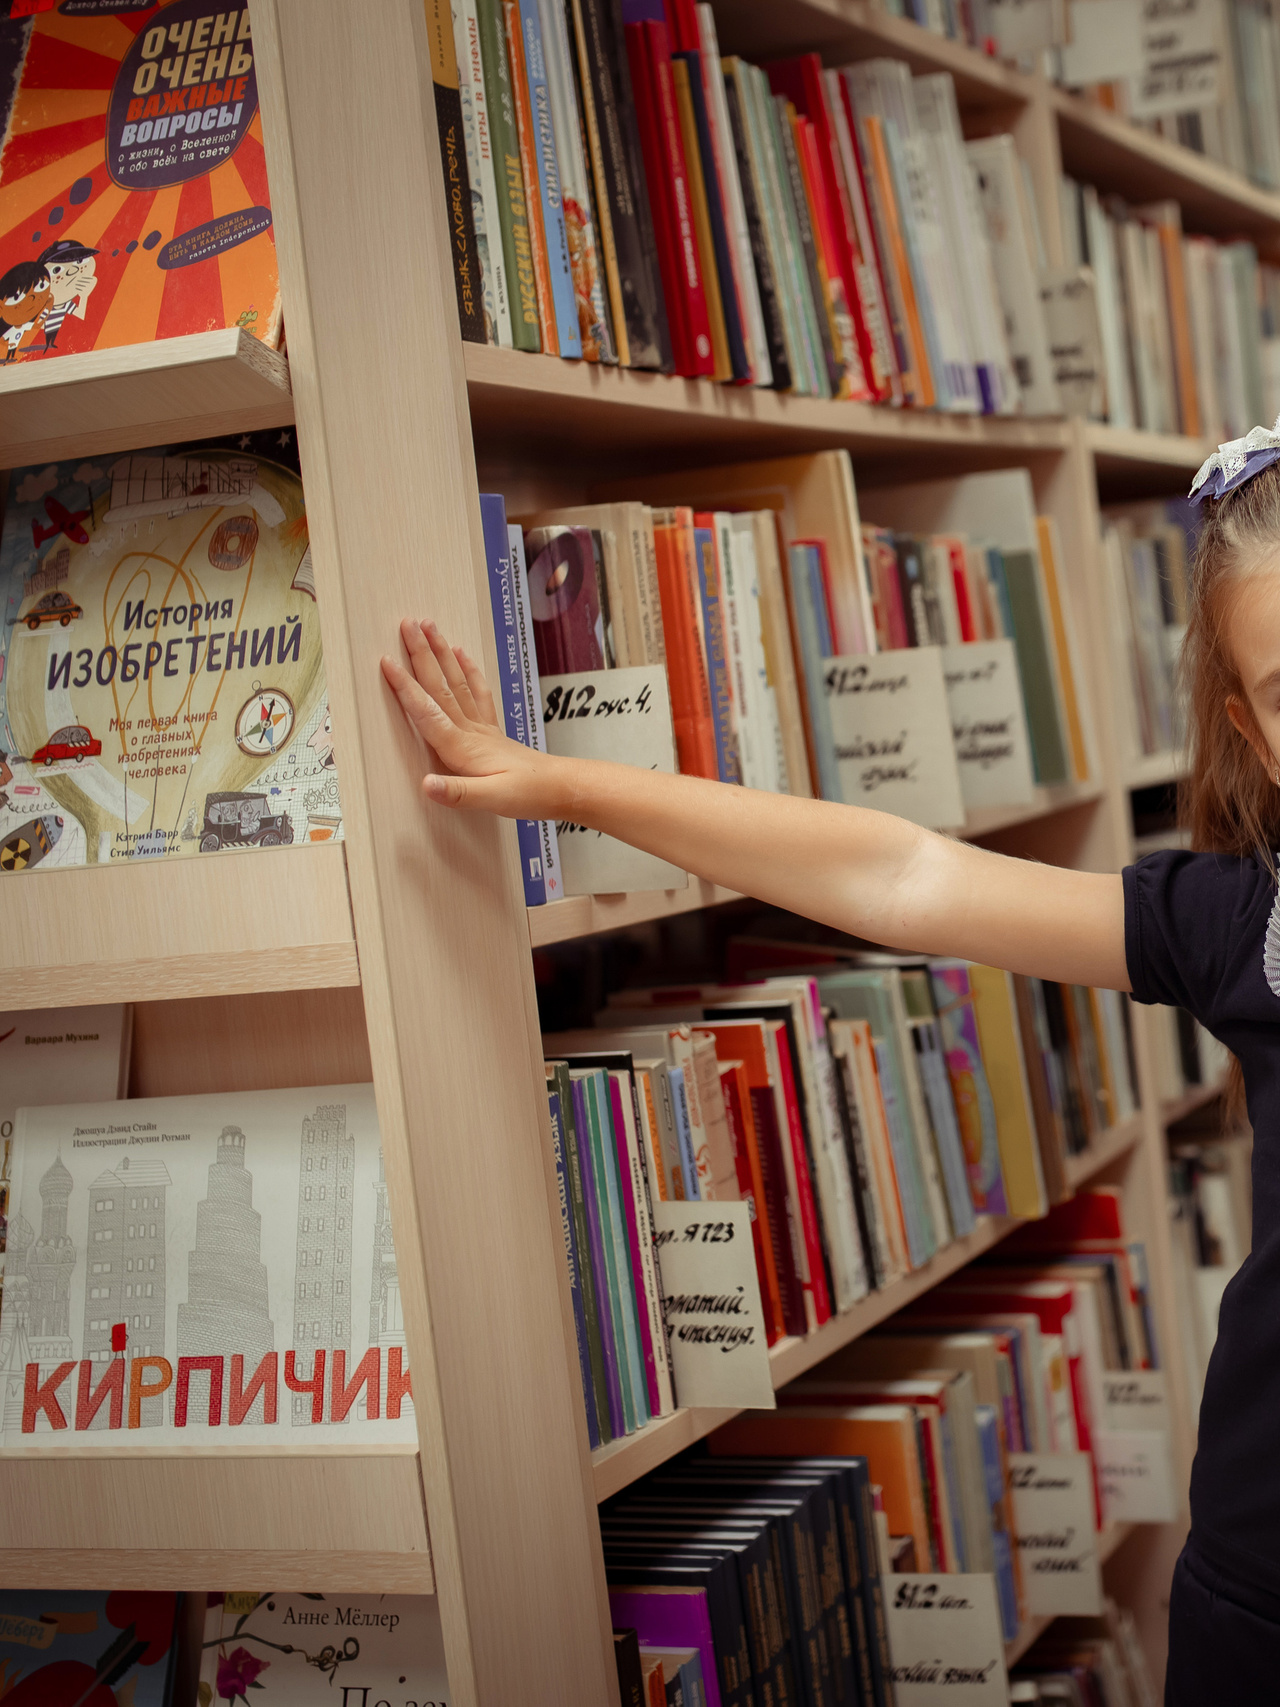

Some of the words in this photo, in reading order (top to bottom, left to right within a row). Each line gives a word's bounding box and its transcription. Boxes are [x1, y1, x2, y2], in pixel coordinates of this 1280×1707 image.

[467, 17, 483, 84] РИФМЫ
[132, 43, 253, 96] ОЧЕНЬ
[126, 76, 249, 122] ВАЖНЫЕ
[120, 102, 243, 147] ВОПРОСЫ
[476, 111, 491, 161] ИГРЫ
[129, 146, 165, 161] жизни,
[170, 144, 176, 153] о
[181, 130, 237, 150] Вселенной
[130, 160, 148, 173] обо
[152, 154, 178, 169] всём
[182, 152, 195, 163] на
[200, 145, 230, 158] свете
[532, 84, 561, 209] СТИЛИСТИКА
[504, 154, 527, 217] ЯЗЫК
[219, 219, 270, 246] Independent
[510, 218, 539, 324] РУССКИЙ
[510, 545, 522, 599] ТАЙНЫ
[495, 557, 514, 627] Русский
[123, 598, 234, 631] История
[47, 616, 302, 690] ИЗОБРЕТЕНИЙ
[506, 633, 519, 675] язык
[511, 682, 521, 695] и
[543, 685, 596, 723] 81.2
[109, 718, 132, 732] Моя
[137, 715, 179, 730] первая
[183, 711, 218, 724] книга
[131, 736, 138, 746] о
[142, 731, 193, 746] главных
[117, 746, 202, 765] изобретениях
[128, 764, 187, 779] человека
[110, 847, 135, 858] Стив
[137, 844, 181, 857] Уильямс
[116, 831, 152, 843] Кэтрин
[155, 829, 179, 841] Барр
[25, 1035, 63, 1046] Варвара
[65, 1033, 100, 1044] Мухина
[73, 1127, 105, 1137] Джошуа
[107, 1125, 131, 1135] Дэвид
[132, 1122, 157, 1132] Стайн
[73, 1138, 127, 1148] Иллюстрации
[161, 1133, 191, 1143] Ротман
[21, 1345, 414, 1433] КИРПИЧИК
[282, 1608, 330, 1626] Анне
[334, 1606, 401, 1632] Мёллер
